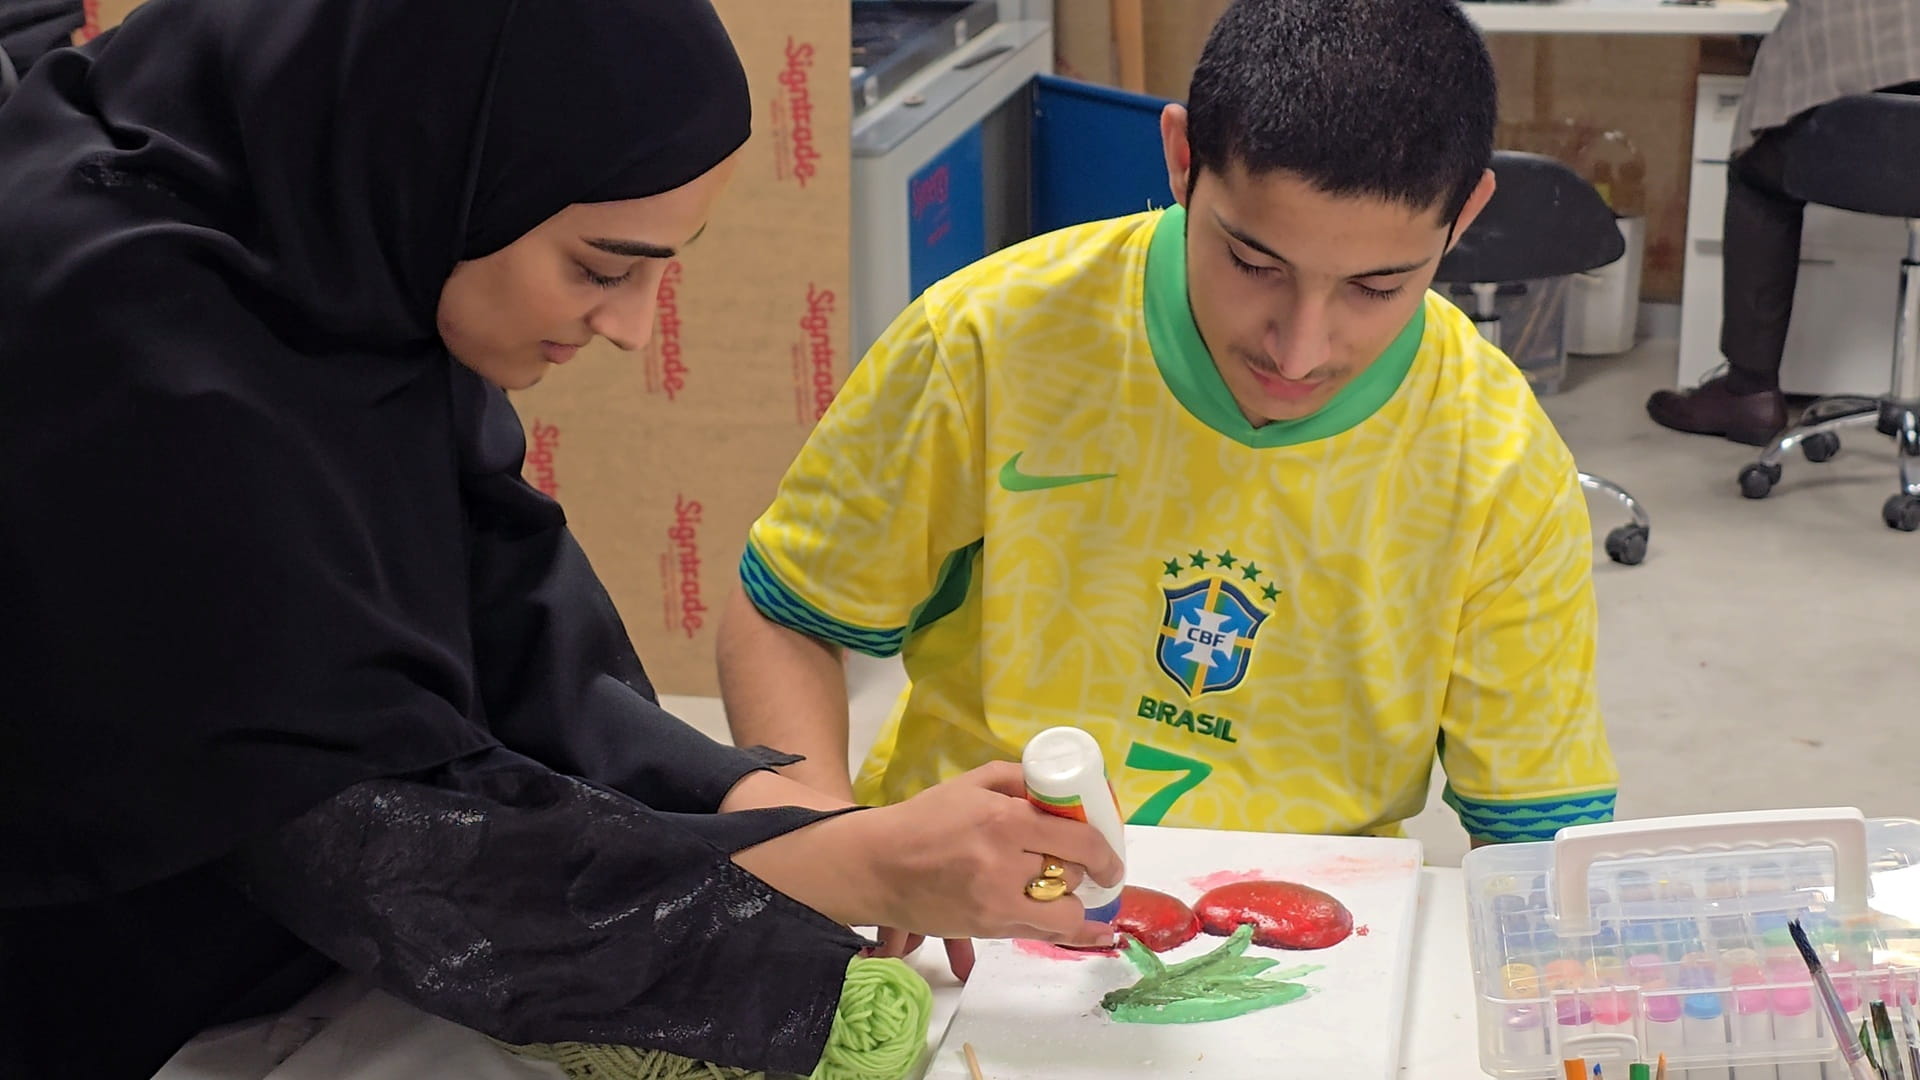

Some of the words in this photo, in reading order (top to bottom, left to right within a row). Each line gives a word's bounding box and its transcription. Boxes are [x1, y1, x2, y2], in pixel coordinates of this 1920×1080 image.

[777, 35, 821, 188] Signtrade
[668, 493, 708, 639] Signtrade
[1187, 627, 1226, 649] CBF
[1137, 695, 1237, 743] BRASIL
[1124, 741, 1214, 826] 7
